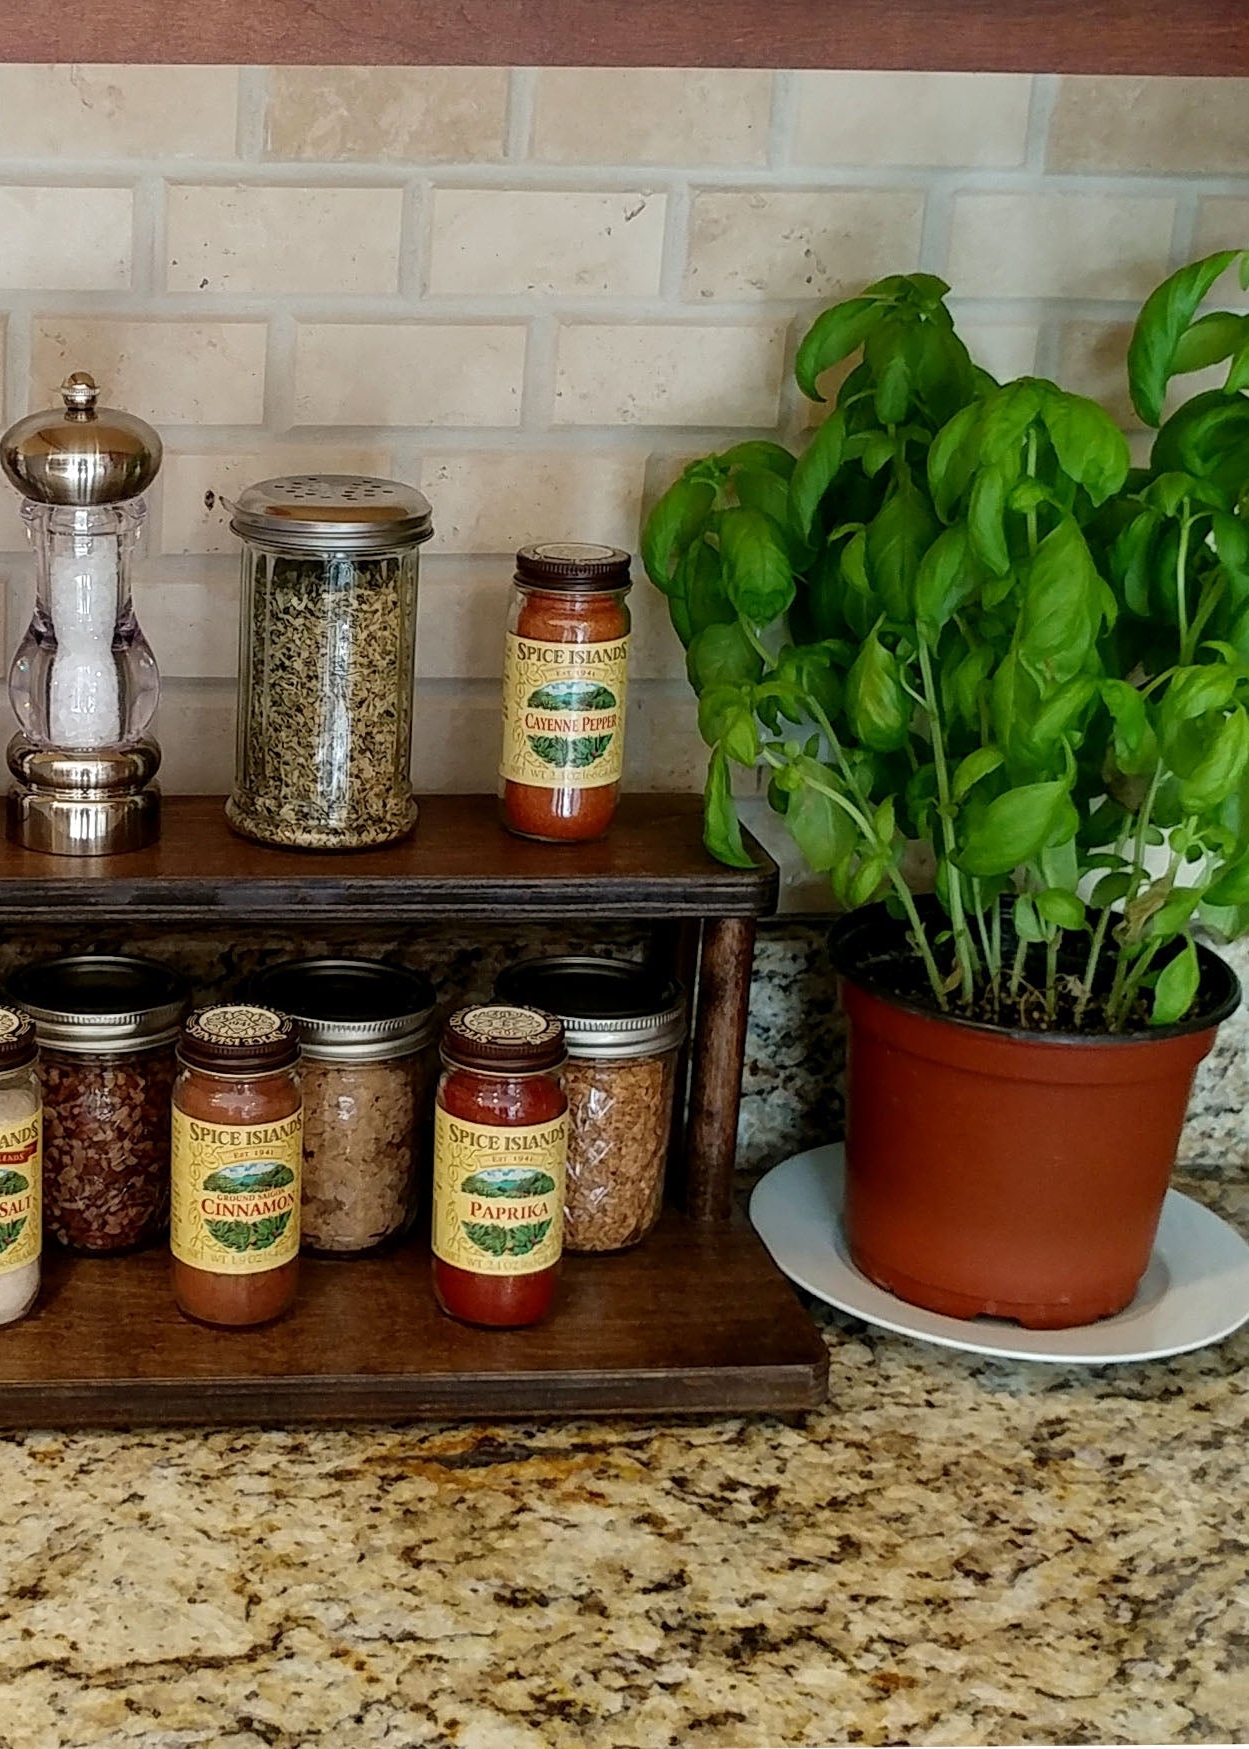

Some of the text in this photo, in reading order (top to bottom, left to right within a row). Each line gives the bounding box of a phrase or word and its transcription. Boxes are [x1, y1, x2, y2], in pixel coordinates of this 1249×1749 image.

[517, 642, 628, 664] SPICE ISLANDS
[525, 712, 617, 732] CAYENNE PEPPER
[189, 1112, 303, 1146] SPICE ISLANDS
[449, 1121, 566, 1151] SPICE ISLANDS
[254, 1149, 274, 1157] 1941
[0, 1194, 33, 1218] SALT
[216, 1194, 255, 1202] GROUND
[470, 1201, 549, 1220] PAPRIKA
